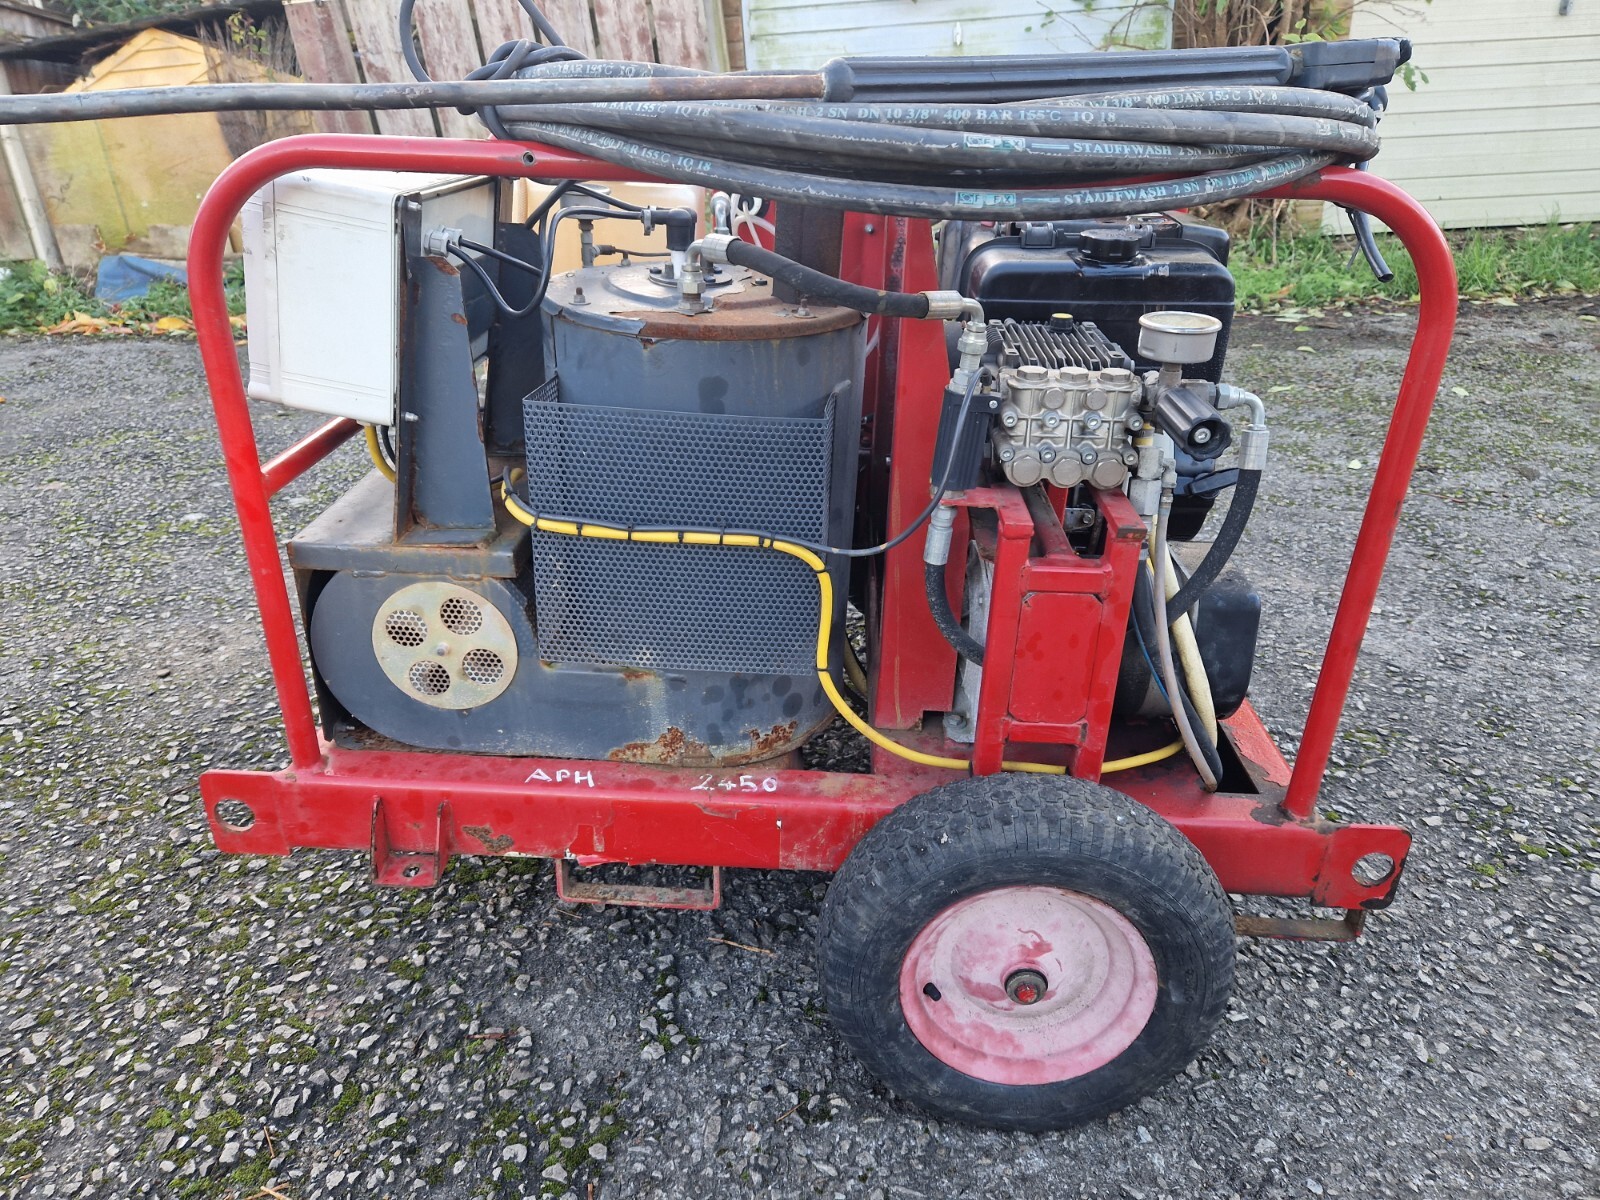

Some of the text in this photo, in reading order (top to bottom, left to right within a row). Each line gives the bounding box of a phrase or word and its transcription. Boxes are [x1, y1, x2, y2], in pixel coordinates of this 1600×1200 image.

[609, 101, 633, 111] BAR
[696, 107, 711, 117] 18
[816, 107, 824, 117] 2
[828, 107, 849, 119] SN
[857, 107, 880, 119] DN
[886, 108, 902, 119] 10
[906, 108, 938, 120] 3/8"
[943, 109, 971, 121] 400
[975, 109, 1013, 121] BAR
[1100, 111, 1116, 122] 18
[599, 135, 615, 146] 400
[616, 140, 638, 155] BAR
[697, 159, 712, 172] 18
[1073, 142, 1172, 155] STAUFFWASH
[1064, 185, 1166, 206] STAUFFWASH
[1173, 184, 1181, 195] 2
[1184, 180, 1200, 193] SN
[1227, 175, 1238, 187] 10
[525, 768, 778, 793] APH 2450
